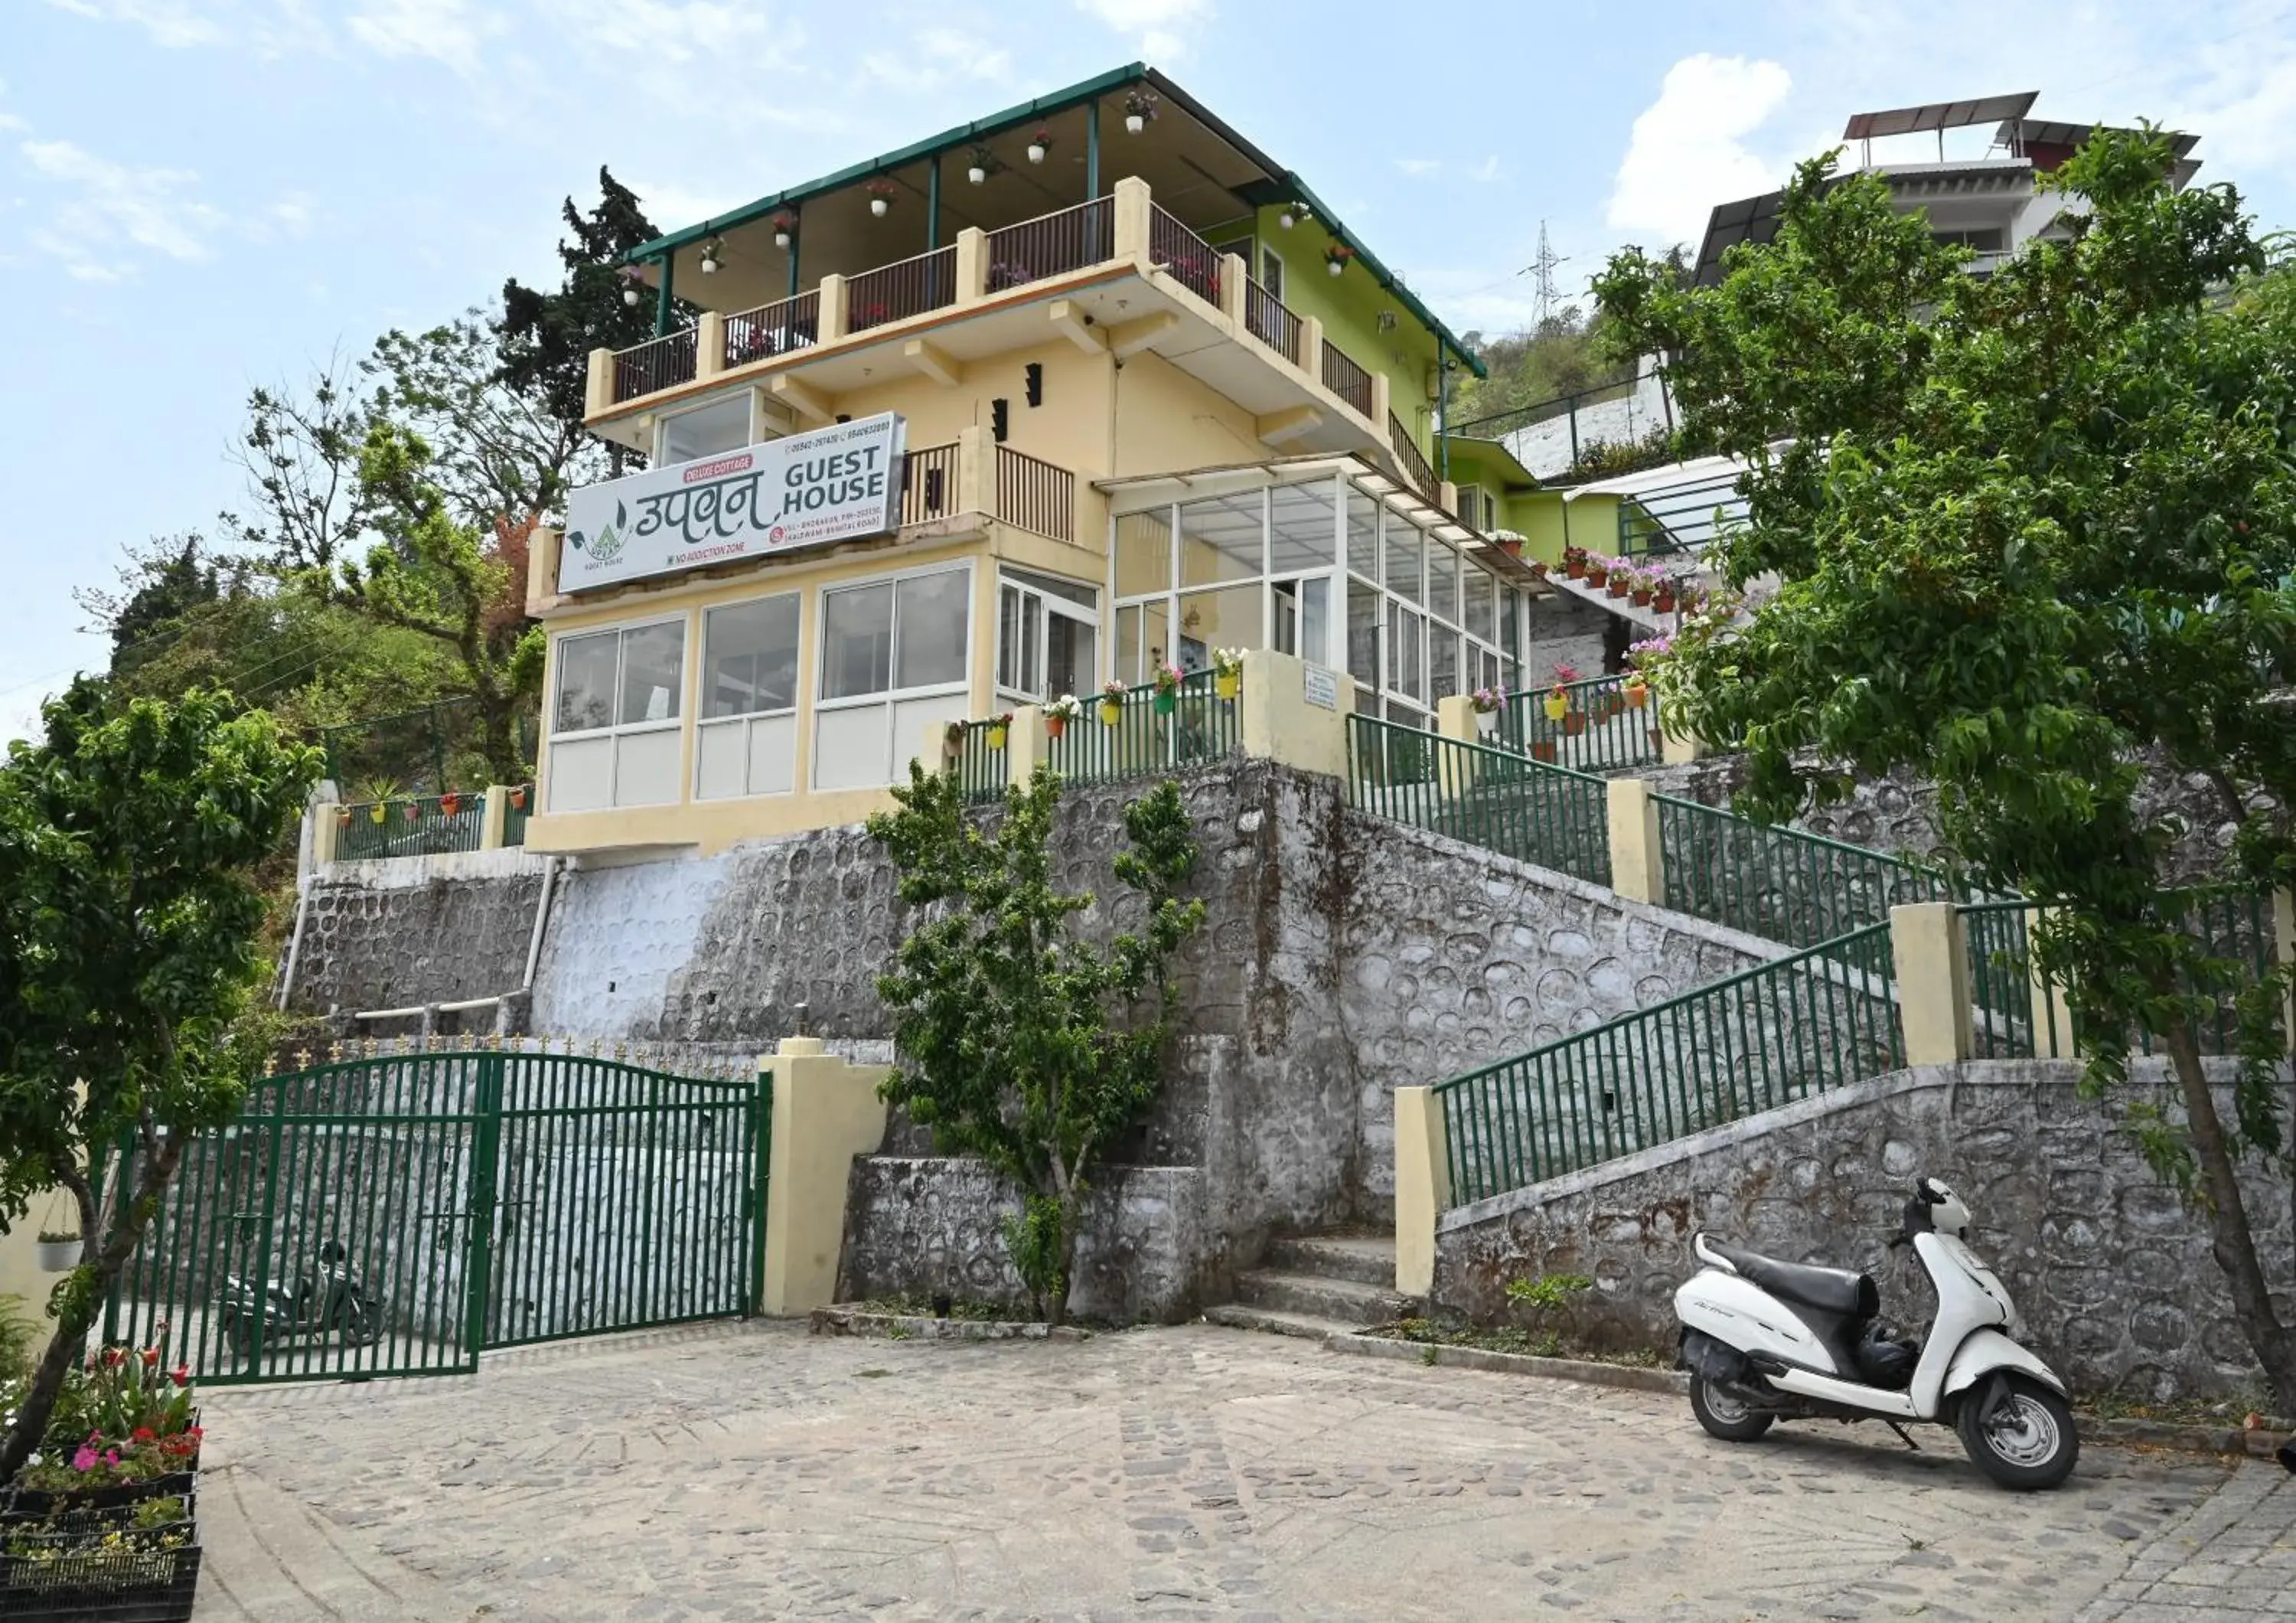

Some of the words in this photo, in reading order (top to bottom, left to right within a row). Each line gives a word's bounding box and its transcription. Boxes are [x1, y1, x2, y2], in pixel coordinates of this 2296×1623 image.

[687, 465, 713, 481] DELUXE
[714, 456, 750, 474] COTTAGE
[785, 446, 880, 488] GUEST
[636, 470, 781, 544] उपवन
[783, 472, 883, 515] HOUSE
[676, 553, 687, 563] NO
[687, 544, 727, 561] ADDICTION
[726, 541, 745, 554] ZONE
